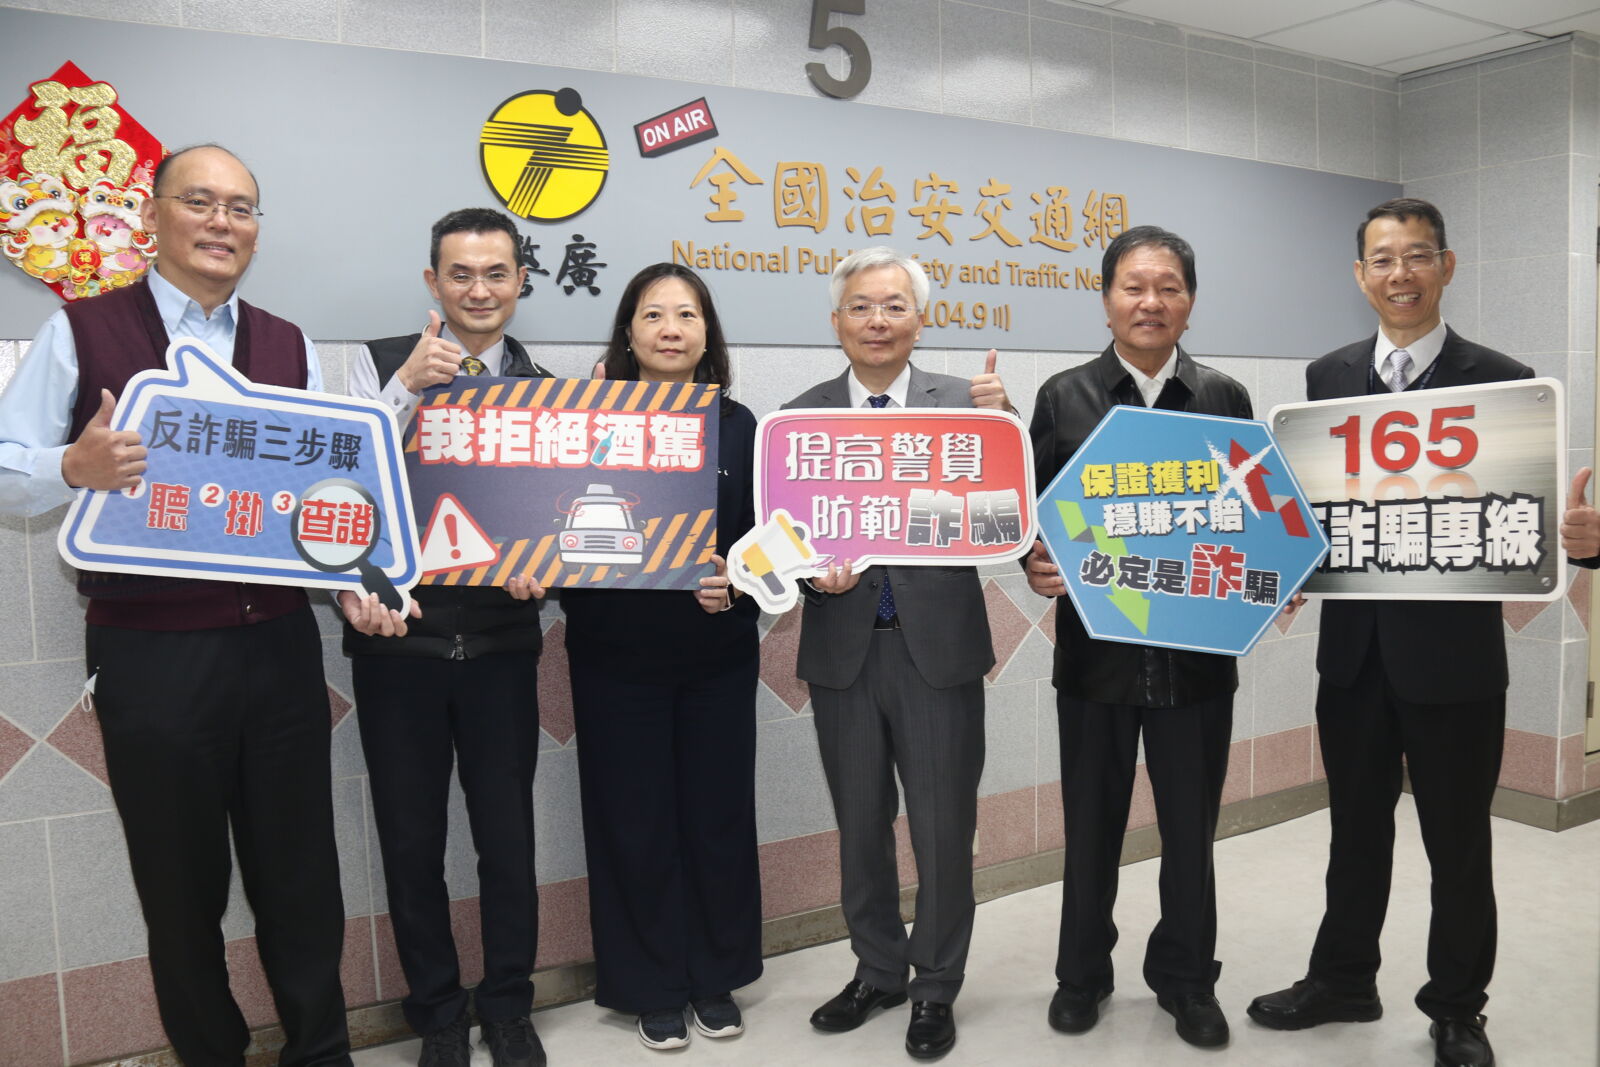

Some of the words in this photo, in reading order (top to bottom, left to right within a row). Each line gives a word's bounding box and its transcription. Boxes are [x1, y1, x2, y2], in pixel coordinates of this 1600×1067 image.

[805, 0, 872, 99] 5
[13, 80, 138, 189] 福
[643, 122, 671, 147] ON
[673, 108, 708, 136] AIR
[689, 146, 1129, 252] 全國治安交通網
[672, 239, 790, 273] National
[959, 260, 1000, 285] and
[1005, 261, 1070, 289] Traffic
[924, 300, 988, 329] 104.9
[148, 411, 362, 472] 反詐騙三步驟
[419, 407, 703, 469] 我拒絕酒駕
[785, 431, 984, 482] 提高警覺
[1329, 404, 1479, 475] 165
[1080, 459, 1220, 497] 保證獲利
[147, 482, 191, 530] 聽
[204, 486, 220, 504] 2
[225, 490, 263, 536] 掛
[277, 494, 291, 511] 3
[298, 500, 374, 546] 查證
[812, 487, 1023, 547] 防範詐騙
[1103, 500, 1244, 537] 穩賺不賠
[1312, 498, 1541, 568] 詐騙專線
[1080, 543, 1280, 606] 必定是詐騙
